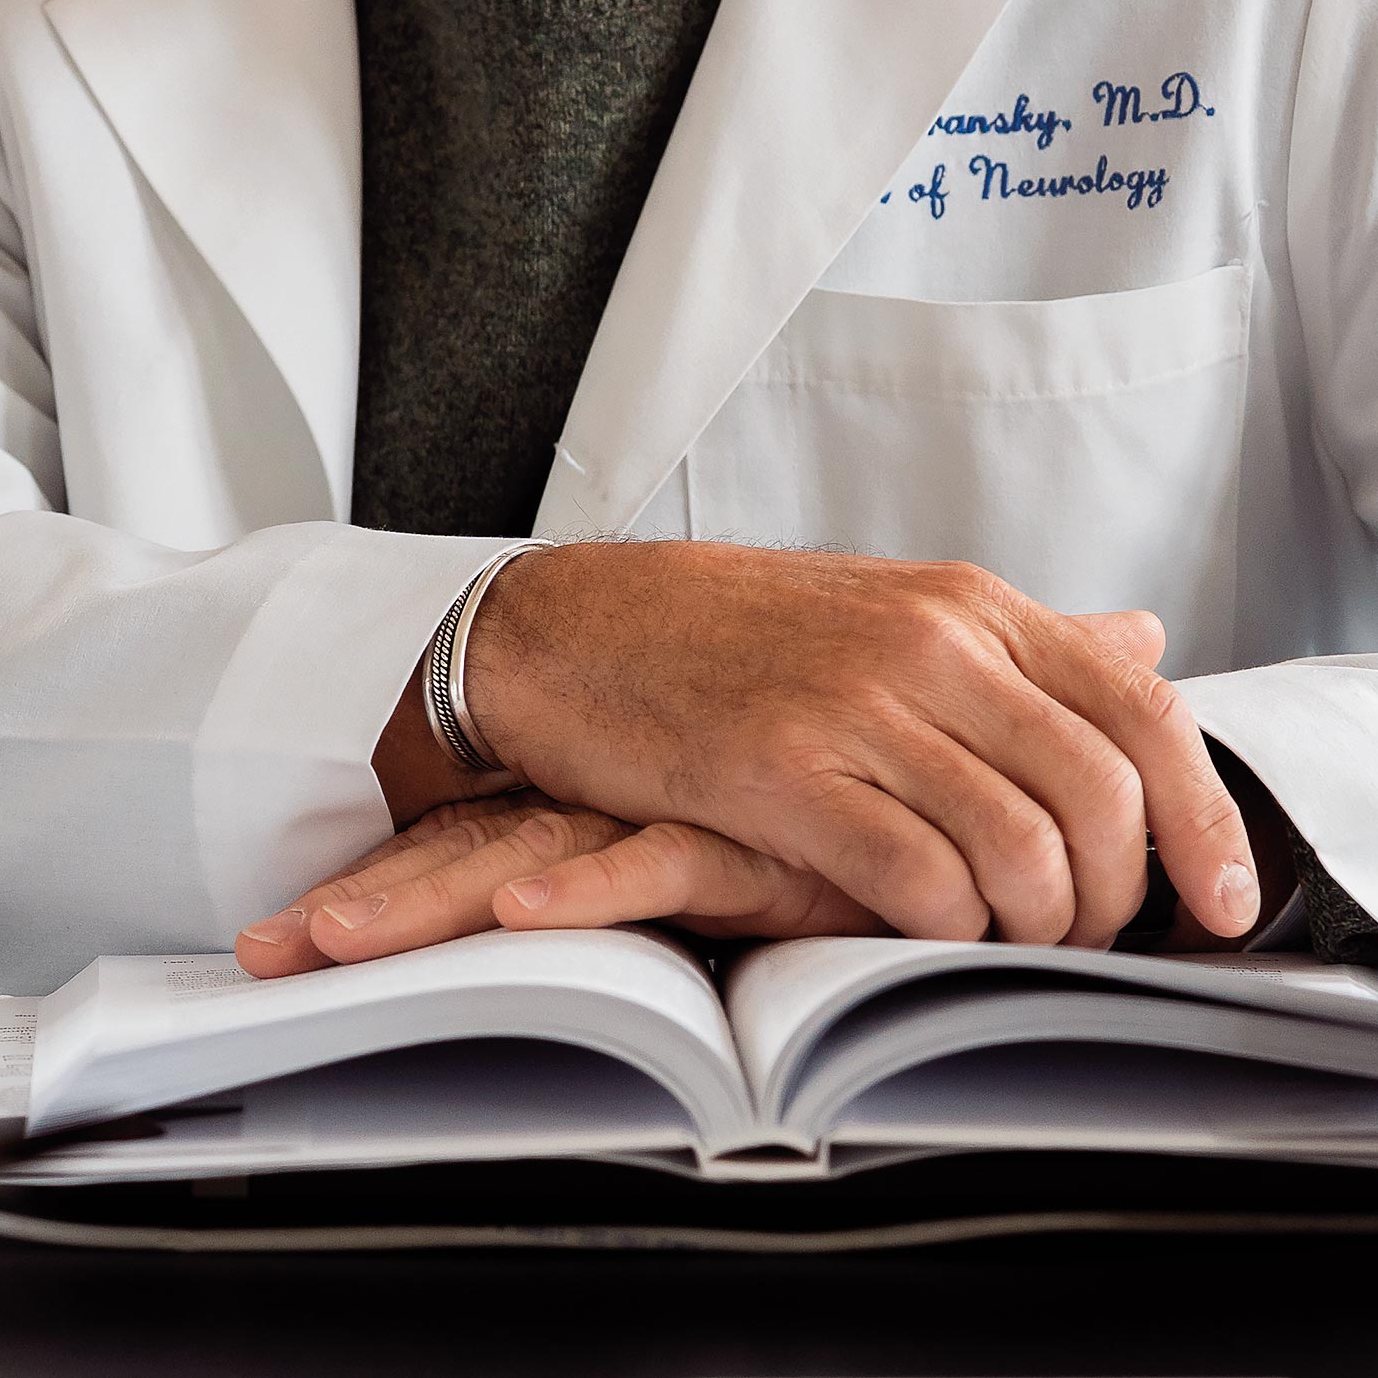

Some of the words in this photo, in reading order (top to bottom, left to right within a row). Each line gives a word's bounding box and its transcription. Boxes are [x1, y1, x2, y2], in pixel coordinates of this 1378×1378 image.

[928, 93, 1072, 151] ransky,
[1092, 72, 1216, 127] M.D.
[908, 164, 950, 220] of
[968, 154, 1171, 210] Neurology
